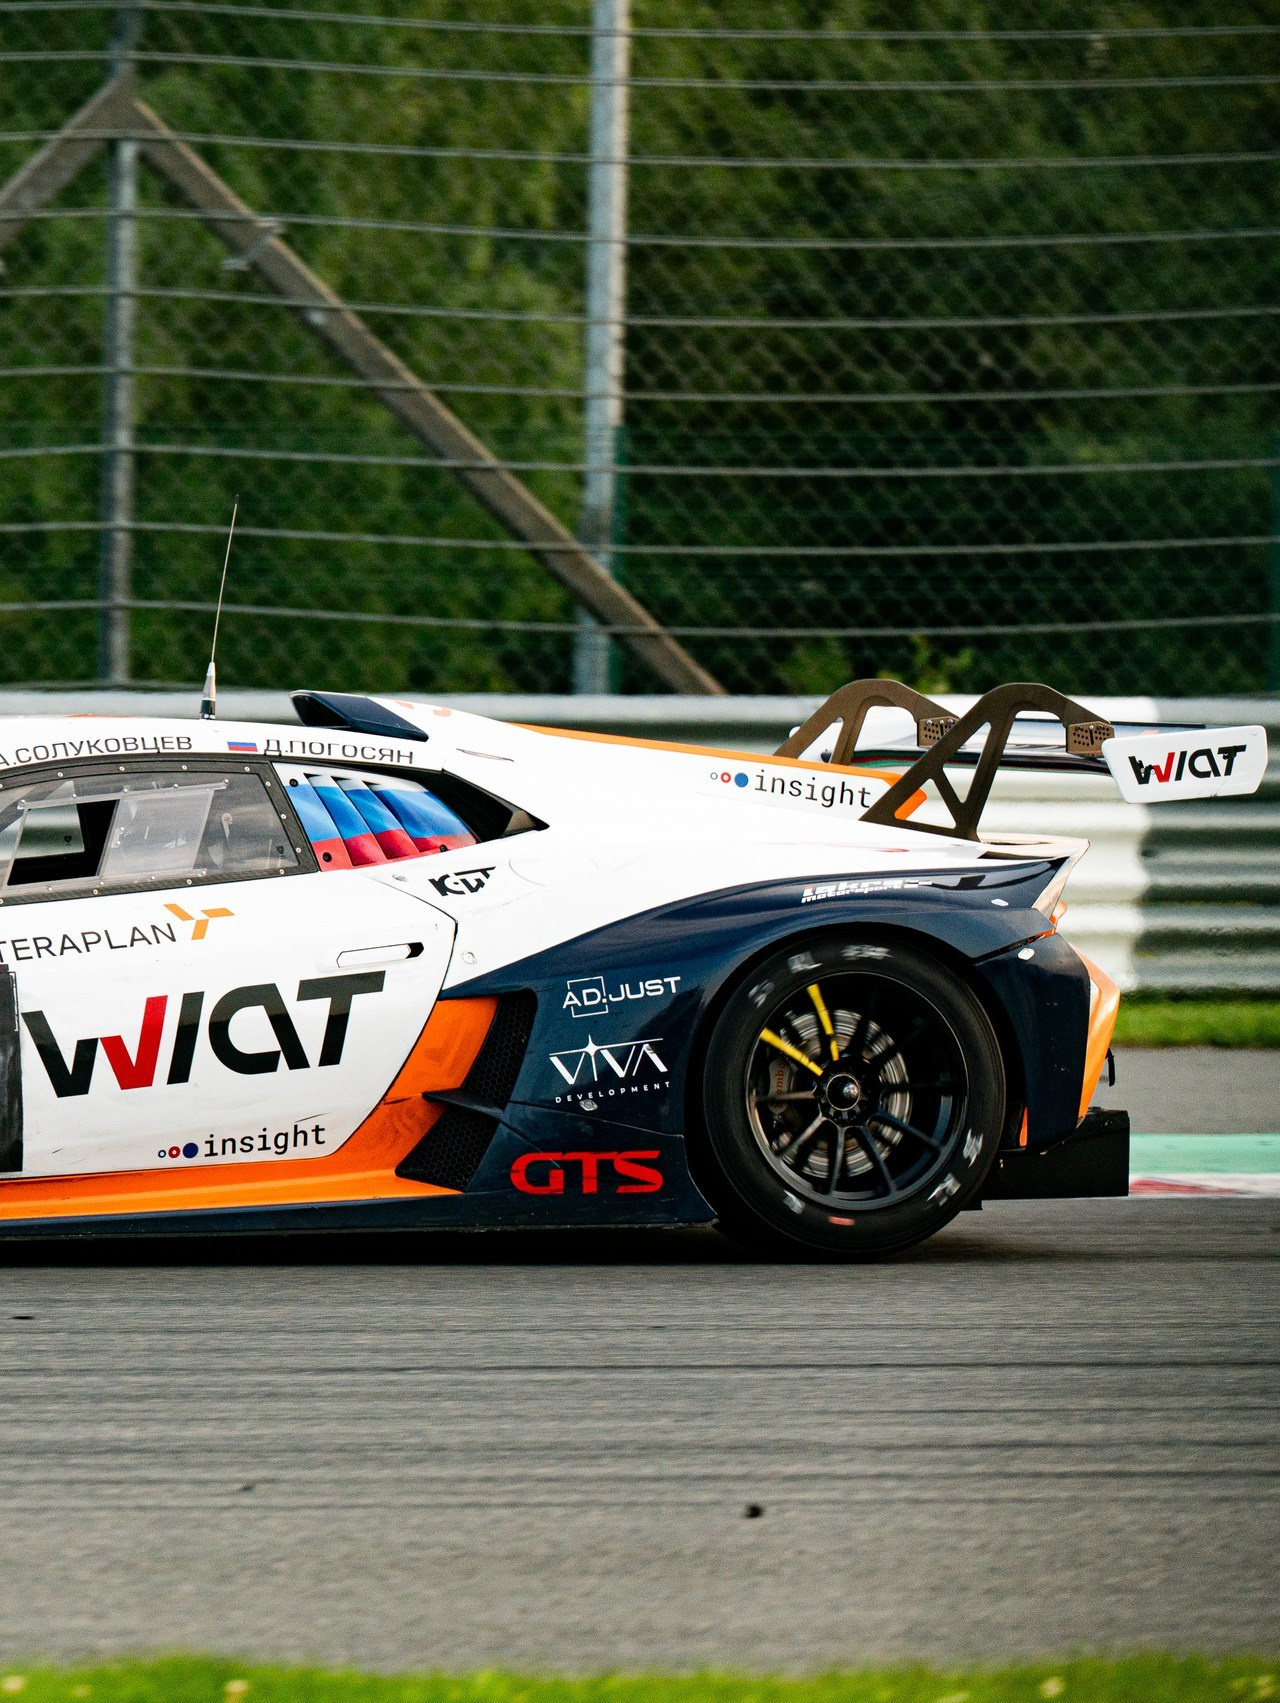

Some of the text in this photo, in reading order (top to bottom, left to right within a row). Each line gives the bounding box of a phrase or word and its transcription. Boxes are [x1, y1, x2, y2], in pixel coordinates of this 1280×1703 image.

[264, 738, 414, 765] Д.ПОГОСЯН
[1127, 744, 1247, 786] WIAT
[754, 769, 873, 808] insight
[22, 970, 385, 1098] WIAT
[549, 1035, 668, 1085] VIVA
[555, 1081, 672, 1104] DEVELOPMENT
[204, 1123, 327, 1159] insight
[510, 1150, 663, 1195] GTS
